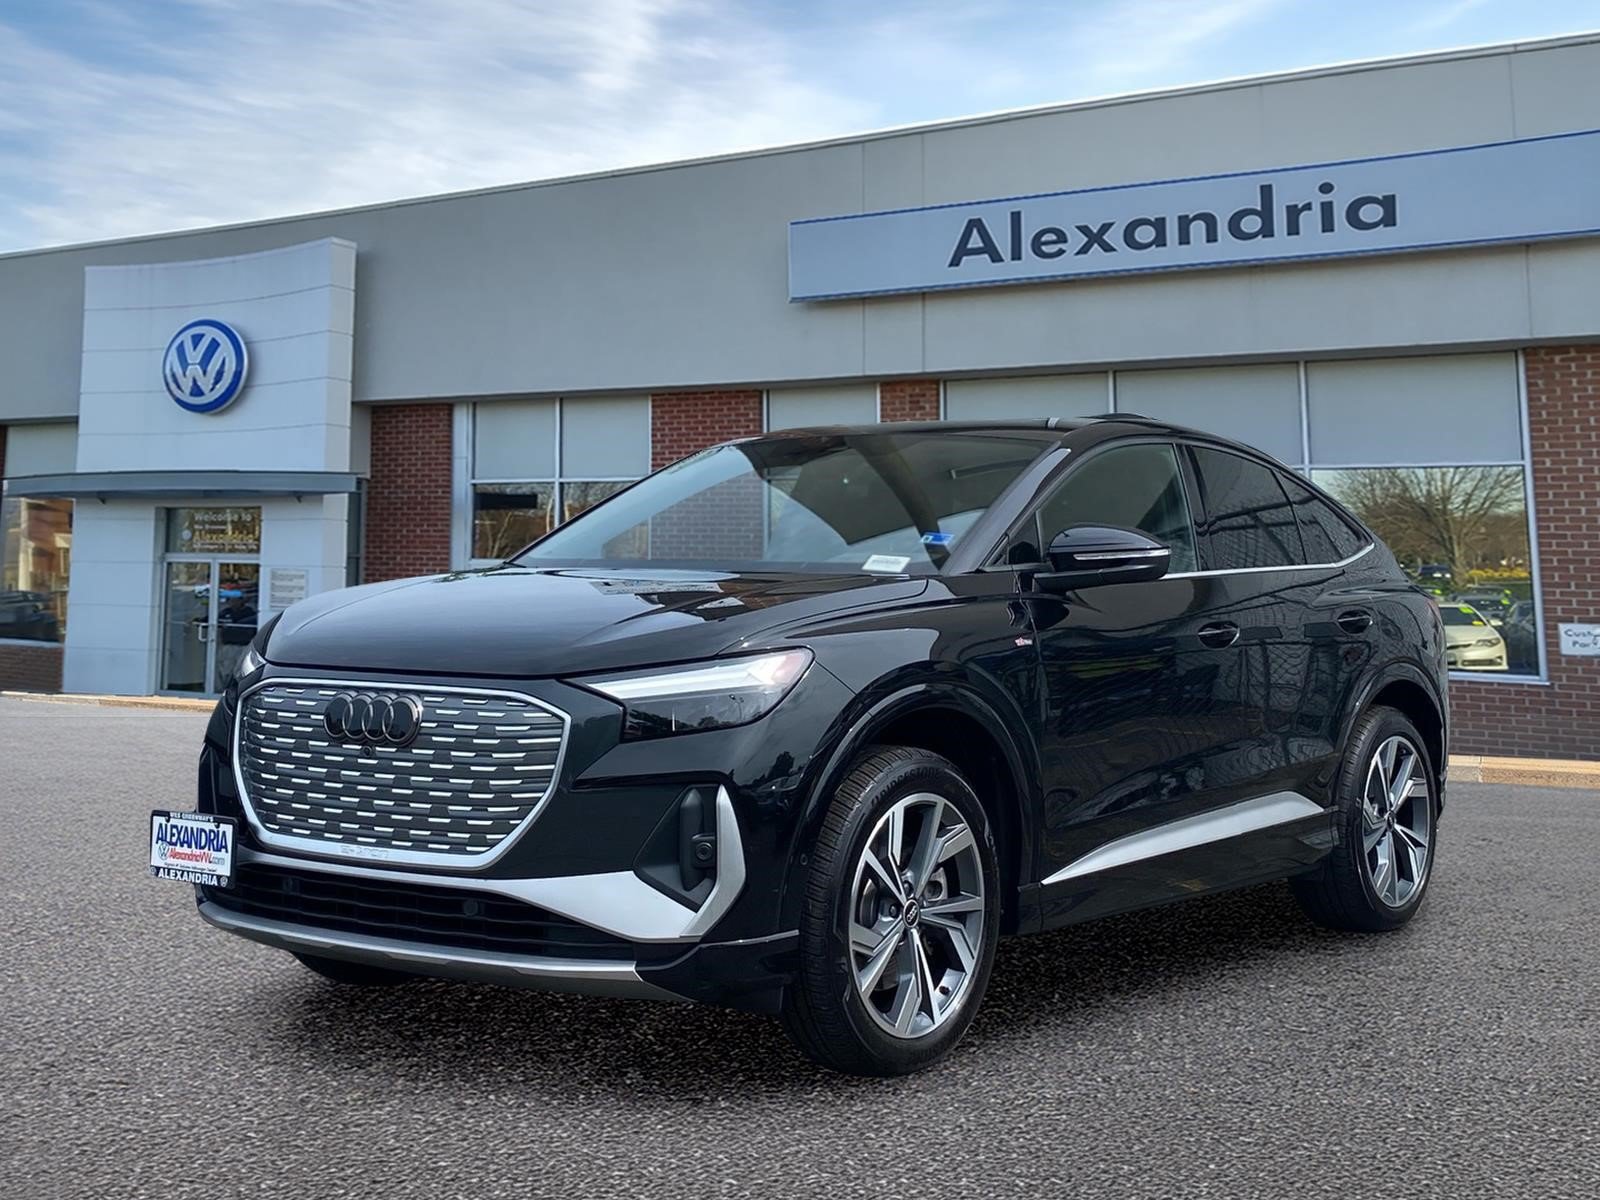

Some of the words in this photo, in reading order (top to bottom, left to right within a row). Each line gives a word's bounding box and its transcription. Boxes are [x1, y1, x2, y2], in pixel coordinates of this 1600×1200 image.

[948, 182, 1397, 268] Alexandria
[166, 325, 236, 405] VW
[156, 823, 228, 853] ALEXANDRIA
[158, 868, 218, 886] ALEXANDRIA
